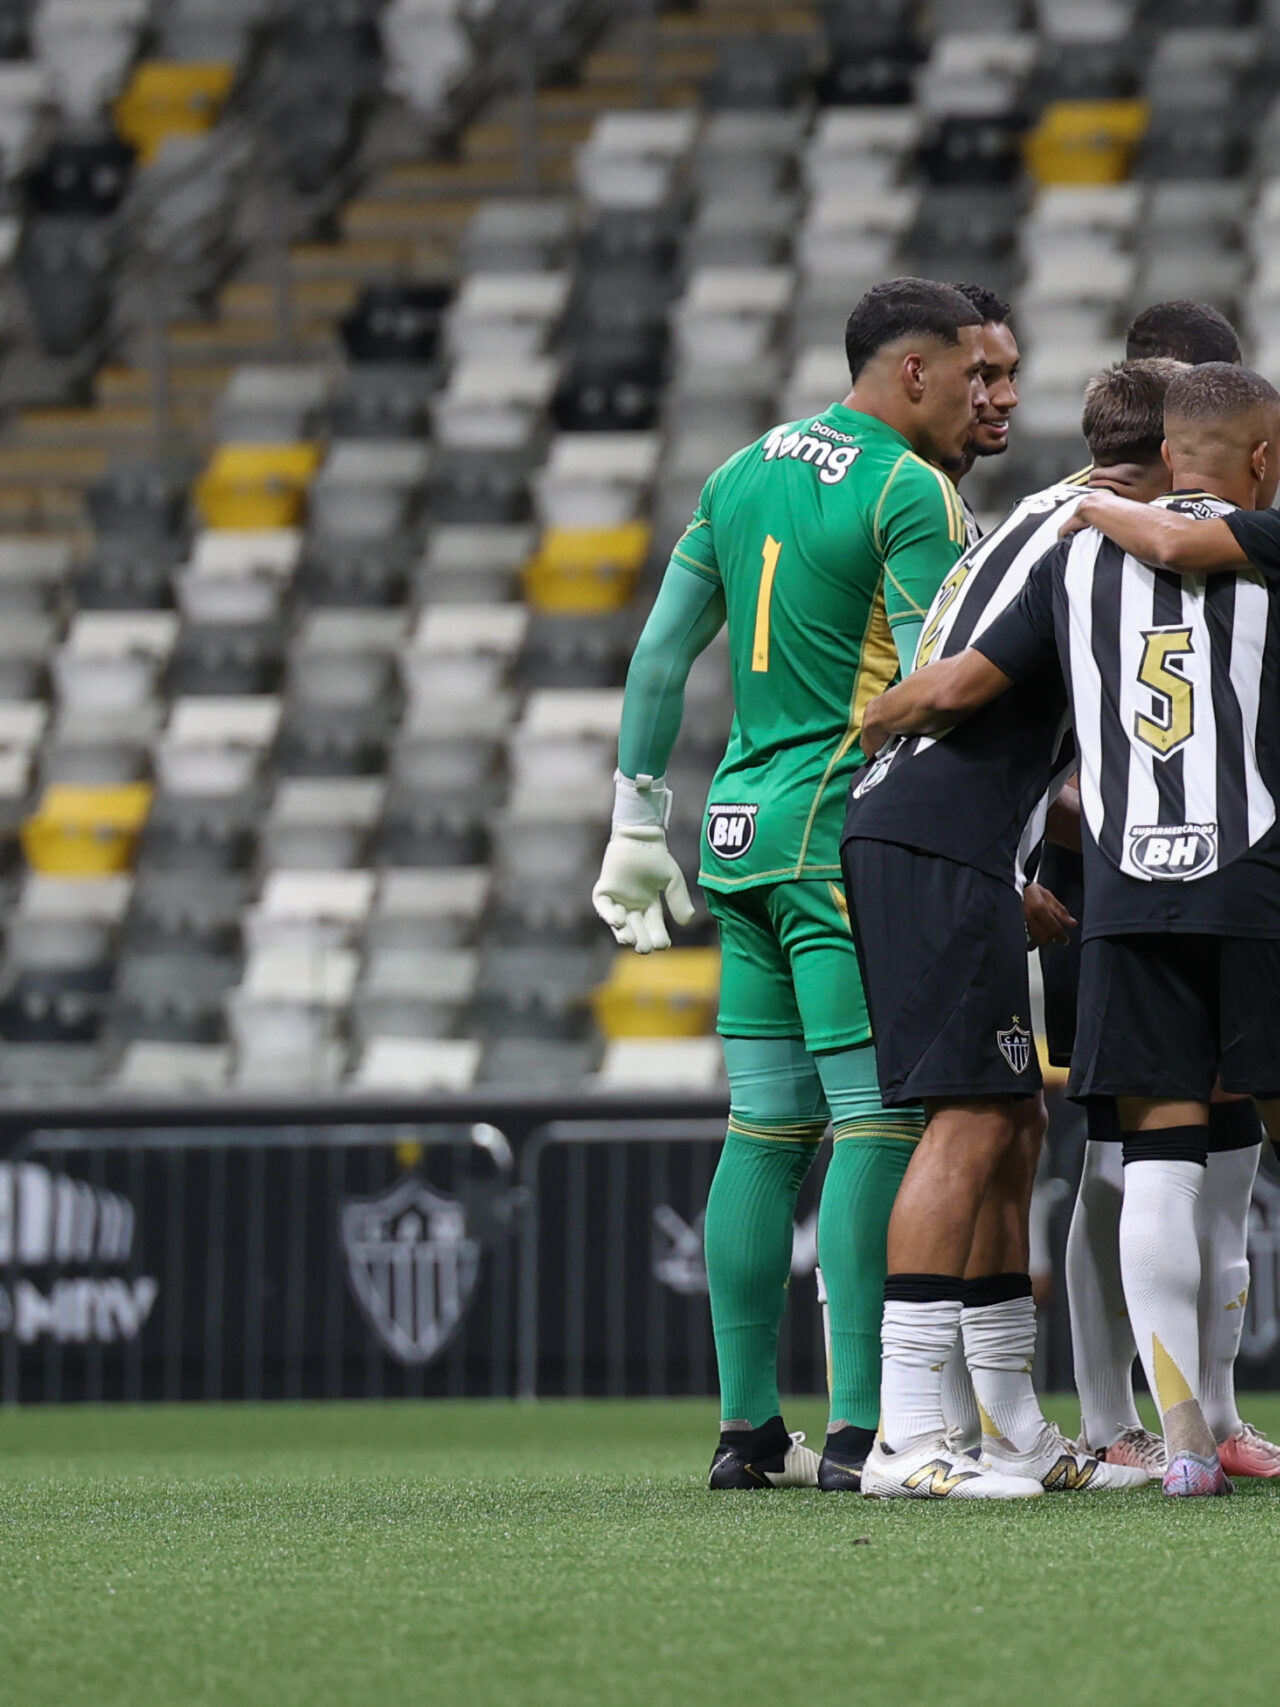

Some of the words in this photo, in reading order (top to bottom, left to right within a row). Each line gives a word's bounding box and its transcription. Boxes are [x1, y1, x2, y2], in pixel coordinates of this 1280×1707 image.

[810, 421, 854, 443] banco
[751, 533, 783, 673] 1
[1134, 626, 1195, 757] 5
[713, 816, 747, 847] BH
[1131, 824, 1215, 836] SUPERMERCADOS
[1142, 836, 1199, 867] BH
